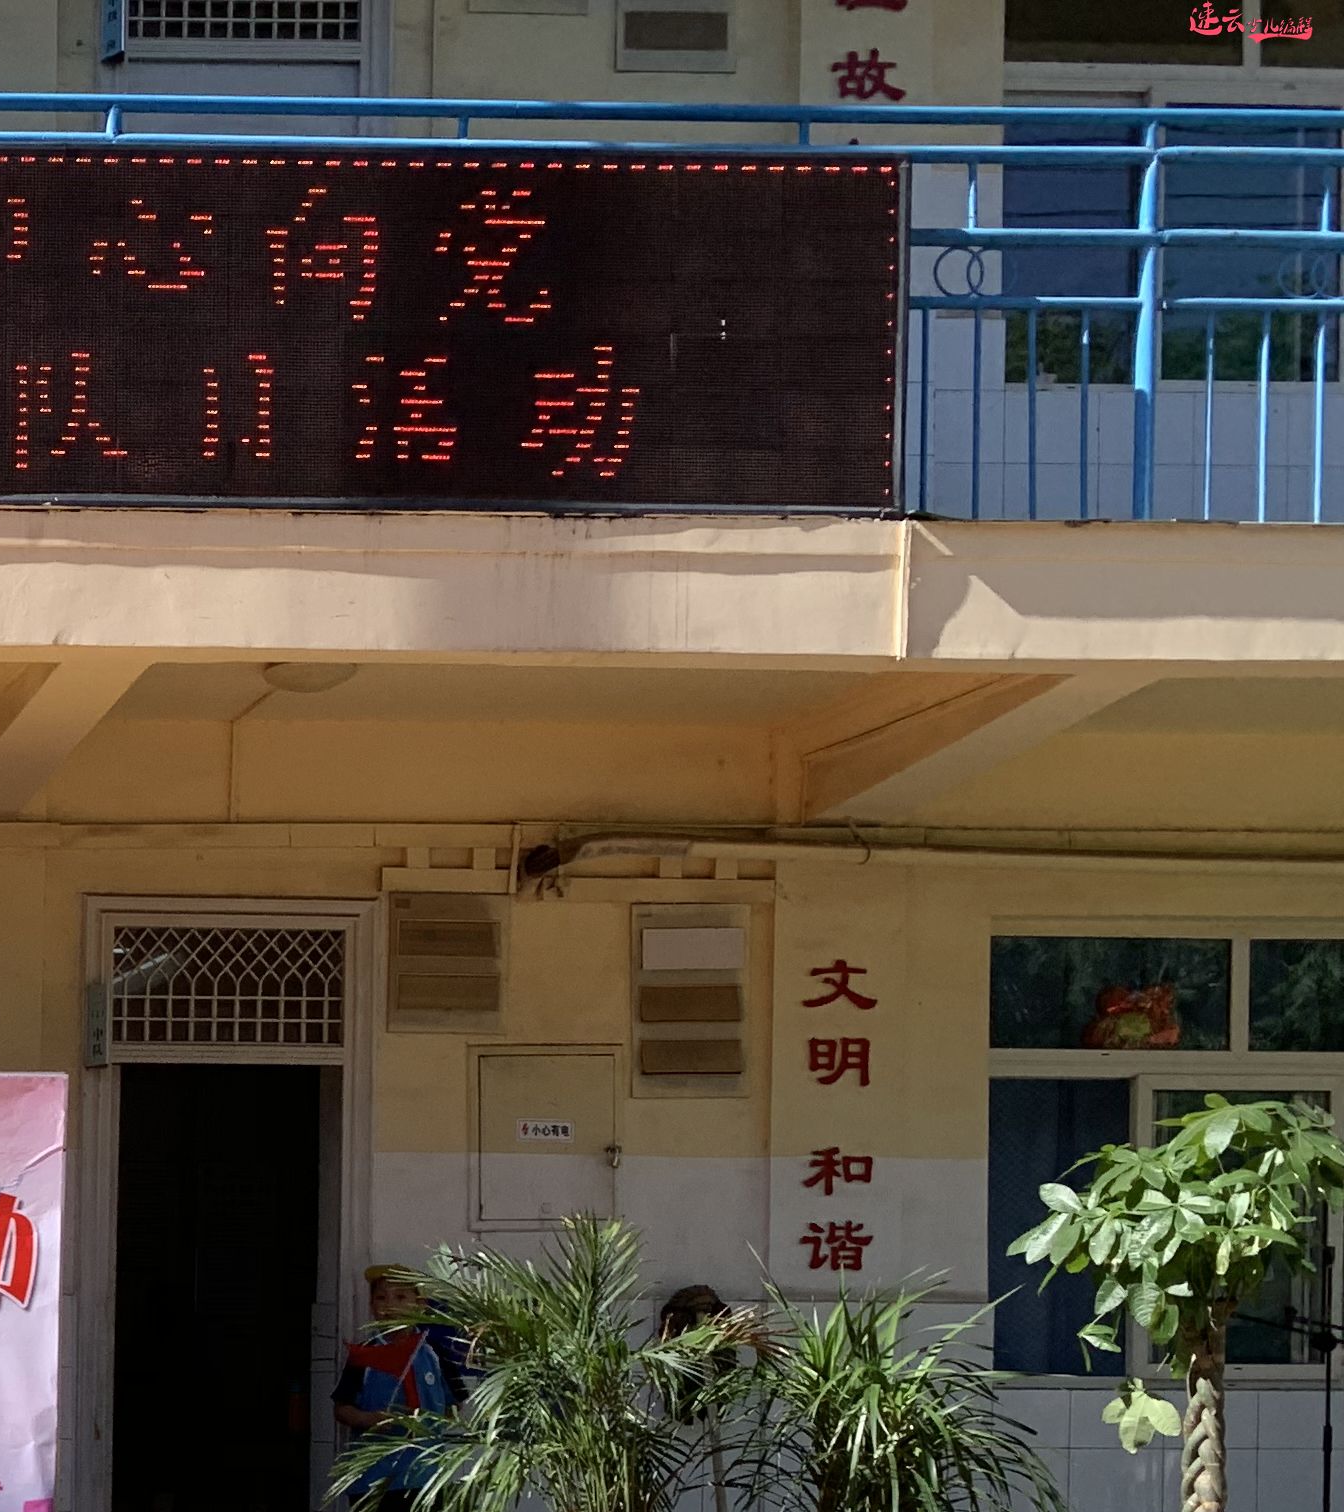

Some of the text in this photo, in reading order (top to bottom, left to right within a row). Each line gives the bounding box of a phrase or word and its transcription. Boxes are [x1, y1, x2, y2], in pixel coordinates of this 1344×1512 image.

[800, 958, 878, 1088] 文明
[531, 1123, 570, 1137] 小心有电
[799, 1146, 874, 1271] 和谐
